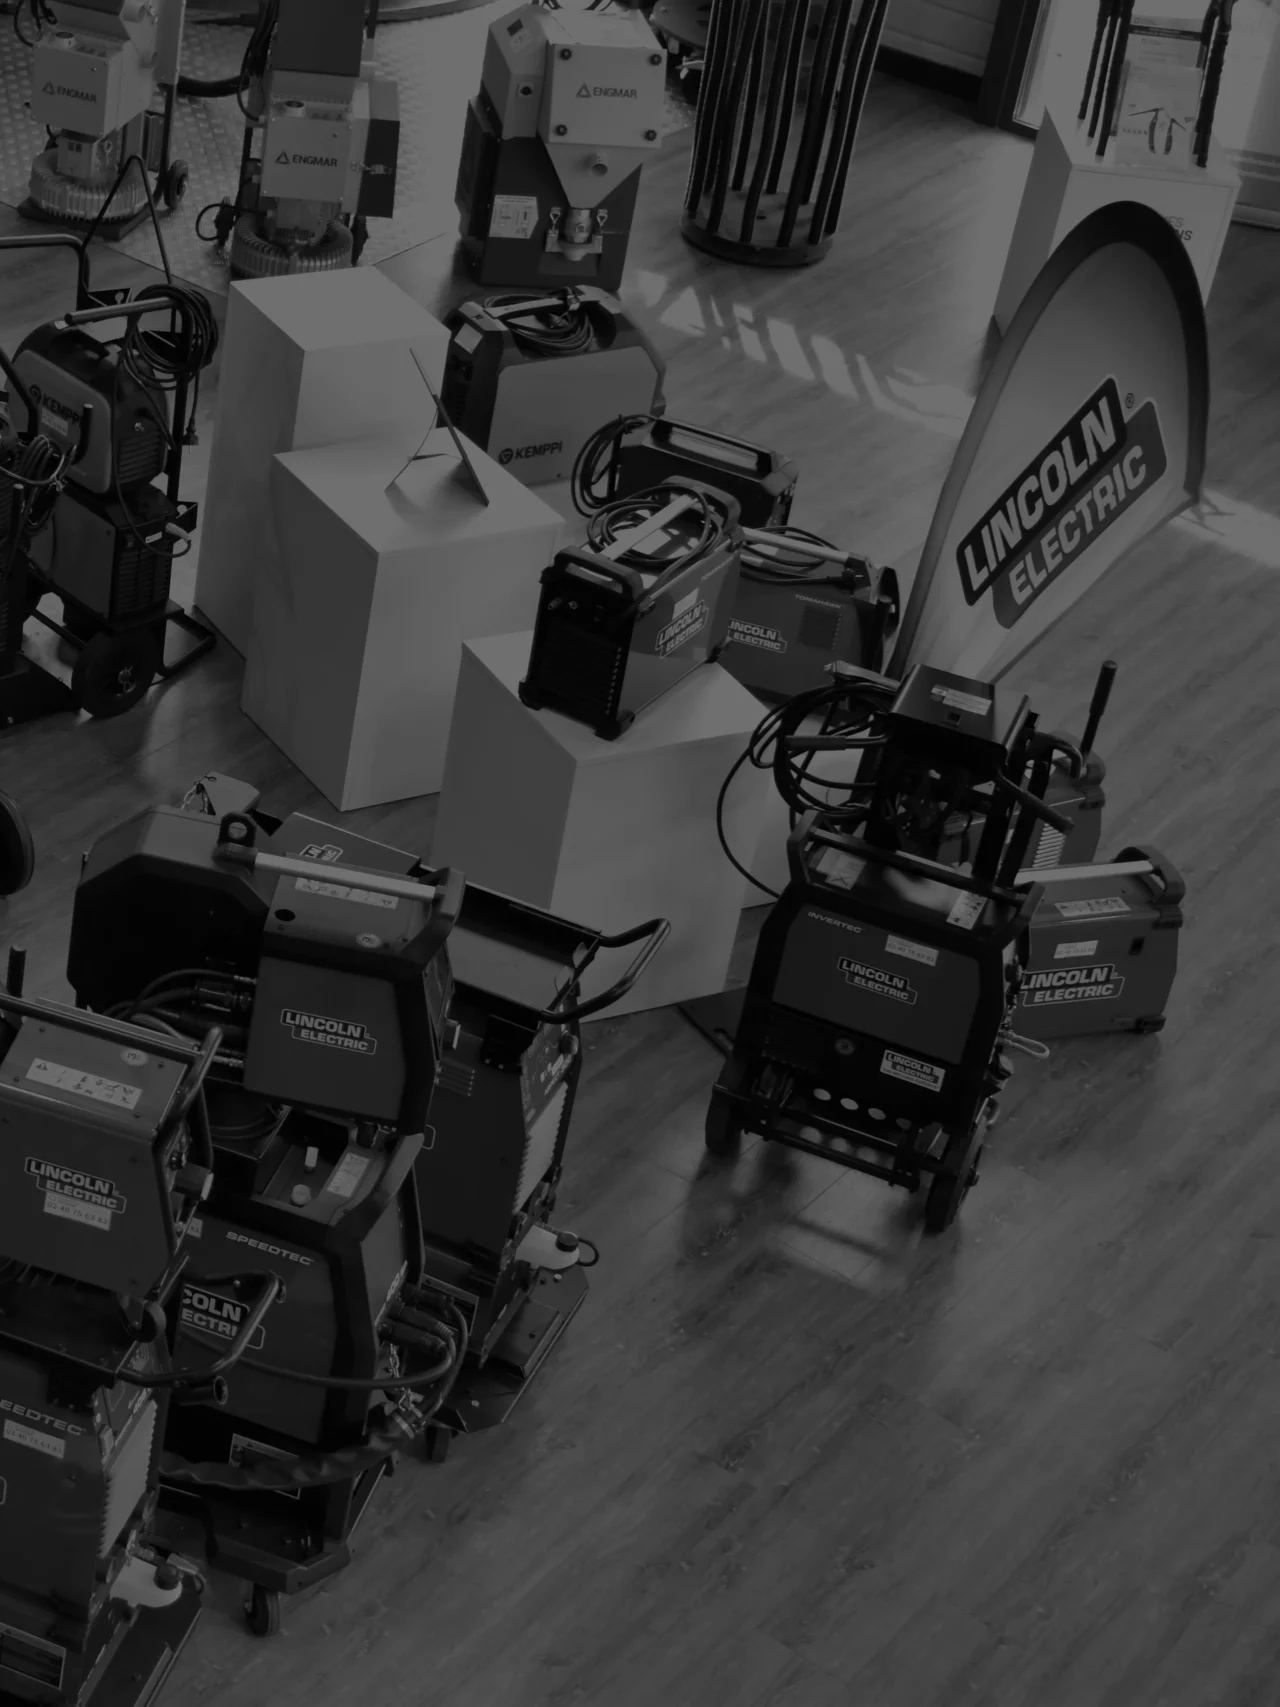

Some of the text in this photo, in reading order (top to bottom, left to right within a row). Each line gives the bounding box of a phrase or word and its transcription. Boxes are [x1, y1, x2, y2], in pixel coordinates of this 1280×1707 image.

[56, 86, 97, 104] ENGMAR
[593, 86, 638, 99] ENGMAR
[292, 154, 338, 167] ENGMAR
[42, 394, 81, 425] KEMPP
[515, 440, 564, 460] KEMPPI
[963, 396, 1117, 592] LINCOLN
[1007, 444, 1147, 606] ELECTRIC
[658, 604, 703, 646] LINCOLN
[665, 617, 703, 653] ELECTRIC
[729, 620, 778, 641] INCOLN
[733, 632, 781, 651] ELECTRIC
[807, 911, 863, 934] INVERTEC
[841, 960, 905, 989] LINCOLN
[1020, 967, 1109, 990] LINCOLN
[853, 976, 910, 1001] ELECTRIC
[1033, 984, 1115, 1004] ELECTRIC
[285, 1012, 362, 1039] LINCOLN
[300, 1028, 369, 1051] ELECTRIC
[887, 1053, 933, 1075] LINCOLN
[895, 1065, 935, 1083] ELECTRIC
[29, 1160, 111, 1195] LINCOLN
[46, 1179, 118, 1209] ELECTRIC
[59, 1206, 71, 1214] 40
[225, 1230, 312, 1266] SPEEDTEC
[182, 1288, 242, 1323] COLN
[181, 1307, 238, 1338] ECTRI
